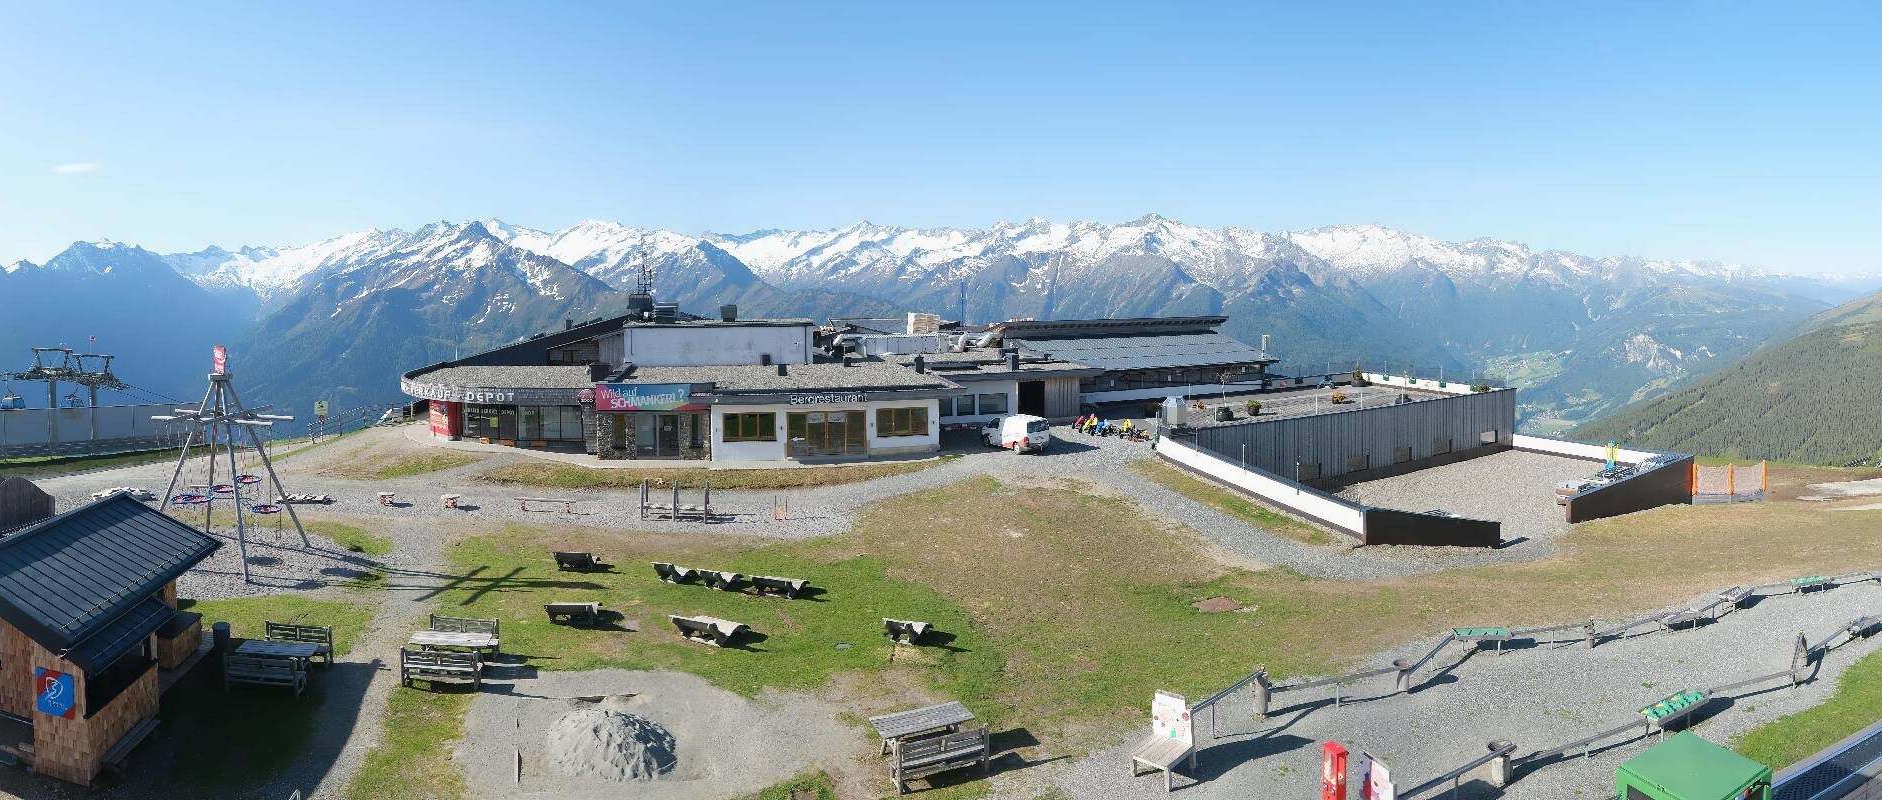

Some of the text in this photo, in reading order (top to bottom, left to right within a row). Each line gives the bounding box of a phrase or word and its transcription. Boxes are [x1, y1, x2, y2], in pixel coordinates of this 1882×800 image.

[466, 391, 515, 402] DEPOT
[600, 388, 621, 400] Wild
[622, 387, 637, 397] auf
[790, 393, 868, 405] Bergrestaurant
